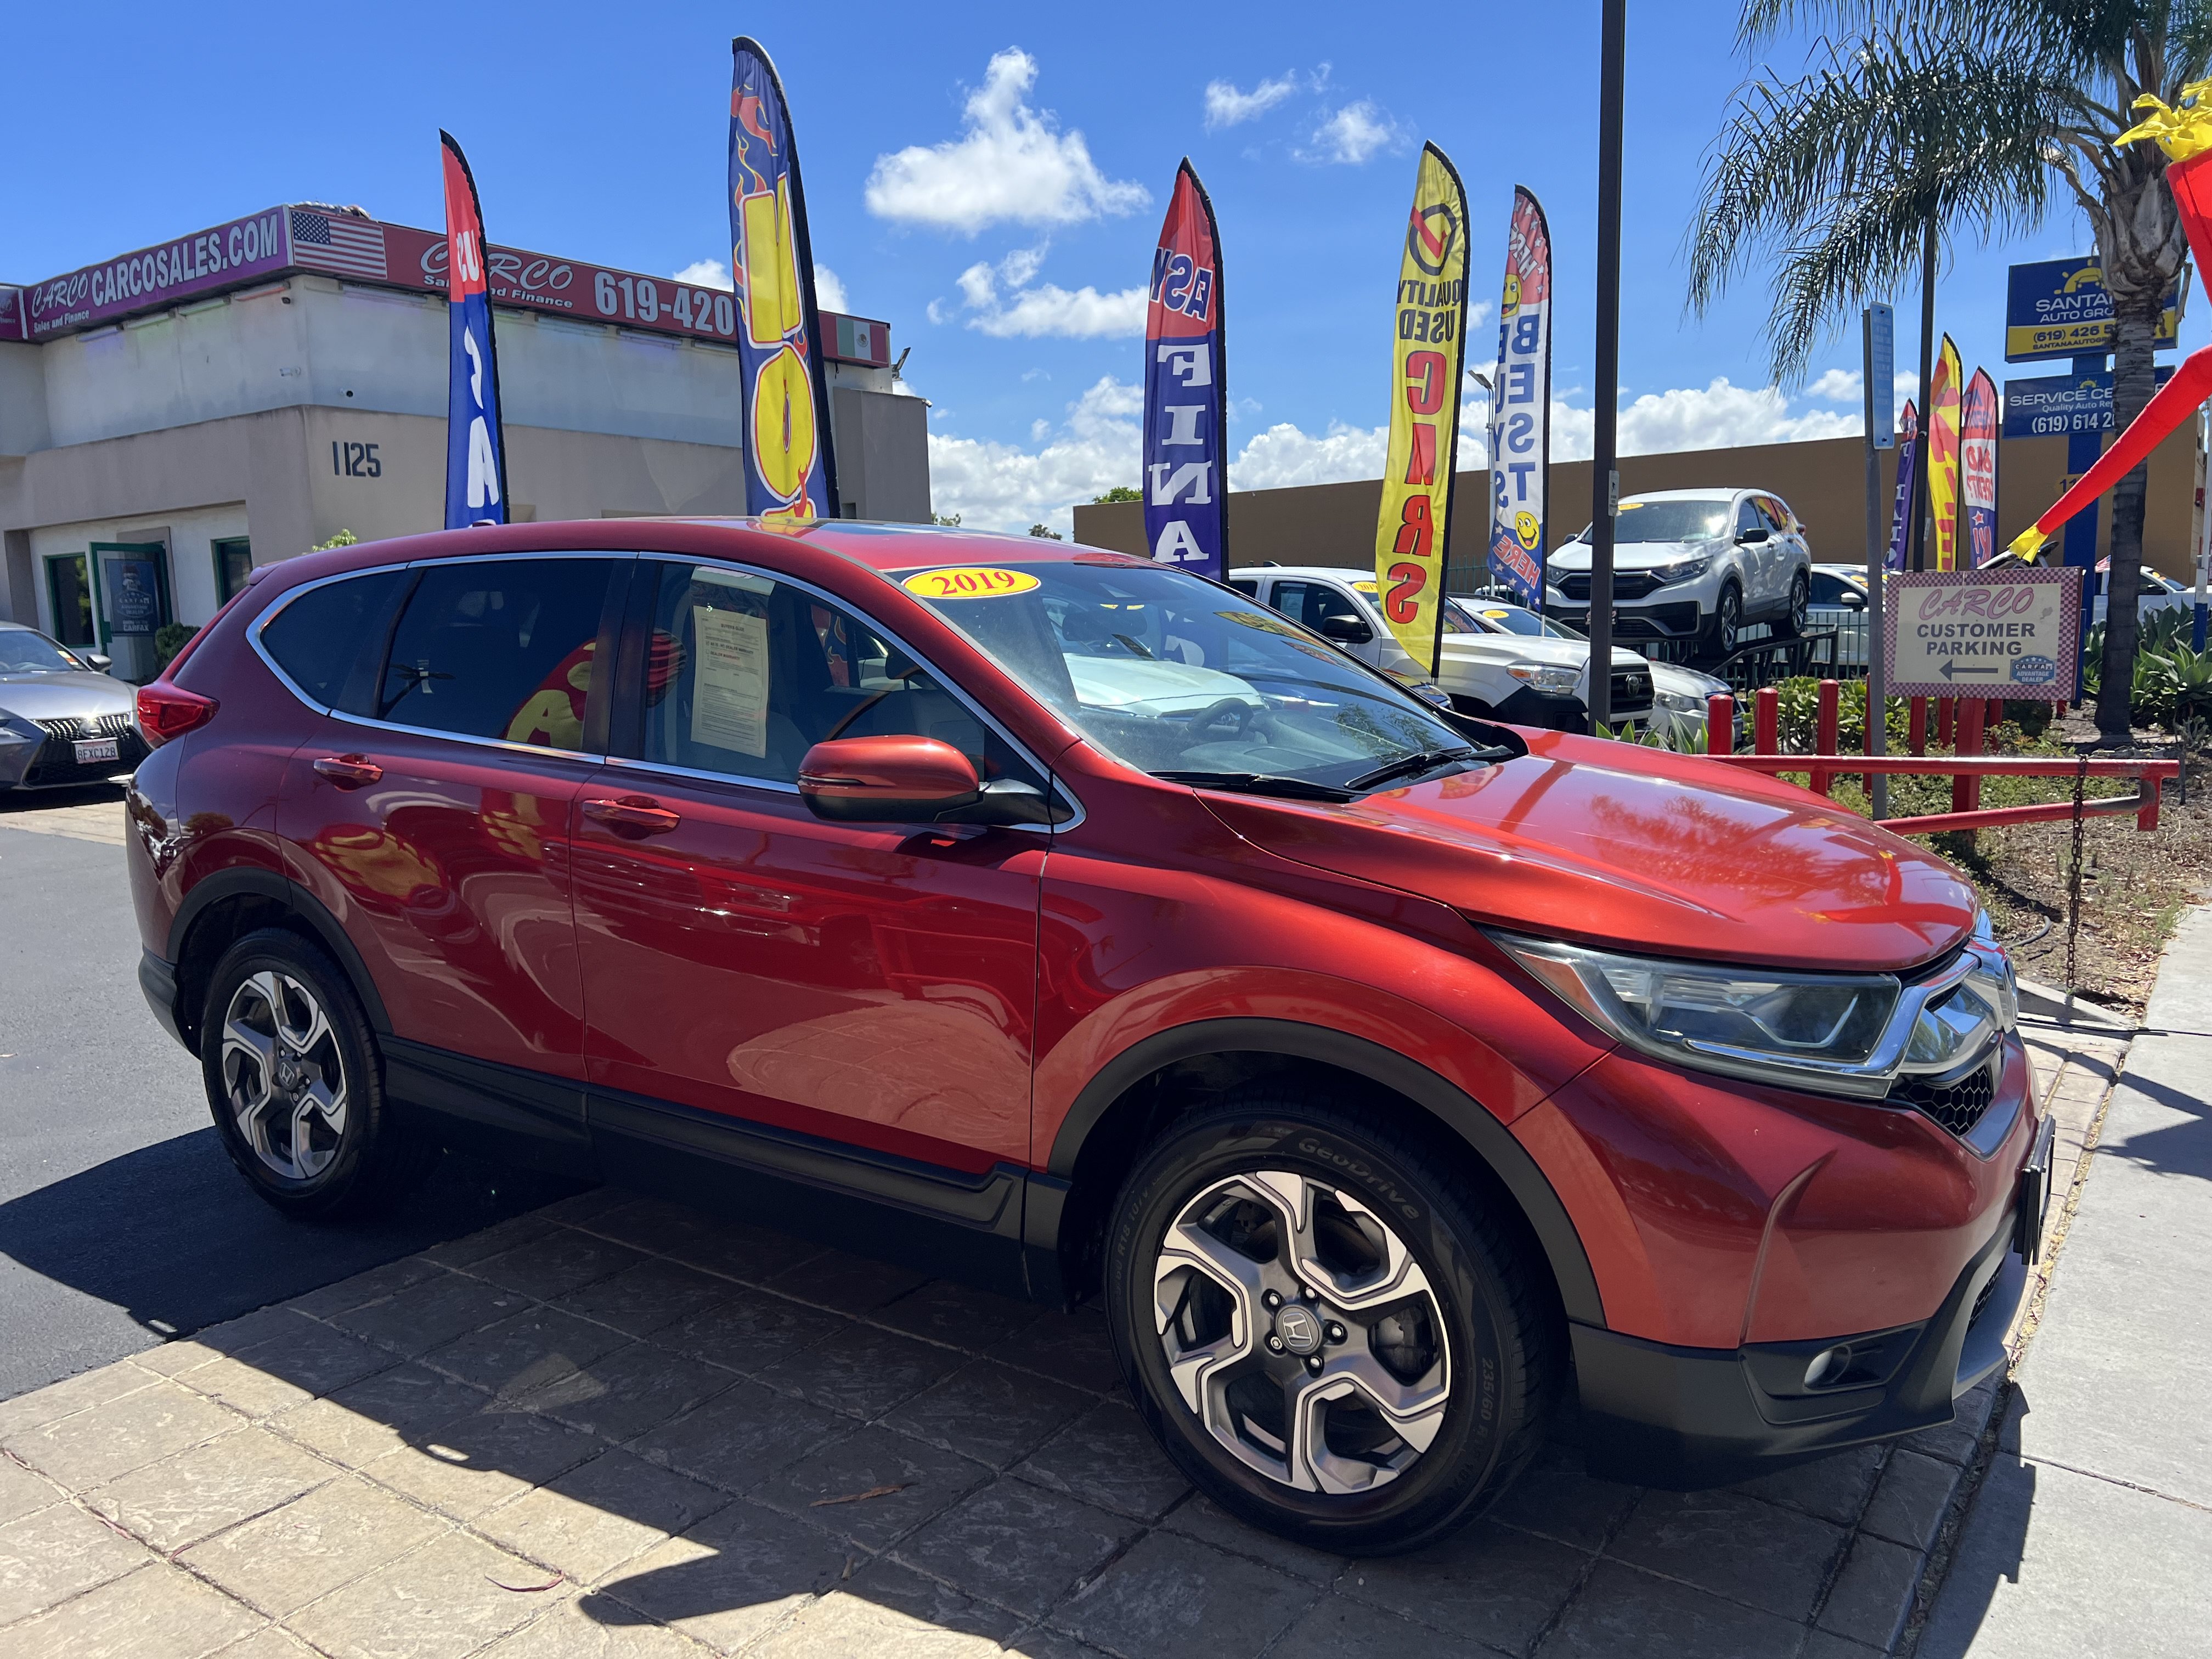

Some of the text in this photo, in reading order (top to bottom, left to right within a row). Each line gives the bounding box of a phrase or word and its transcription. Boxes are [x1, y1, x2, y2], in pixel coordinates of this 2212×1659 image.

[31, 214, 278, 318] CARCO CARCOSALES.COM
[420, 241, 573, 290] CRCO
[511, 289, 573, 308] Finance
[52, 316, 63, 328] and
[64, 309, 89, 325] Finance
[2040, 311, 2080, 323] AUTO
[2033, 329, 2066, 343] (619)
[2070, 325, 2100, 337] 426
[2010, 389, 2087, 407] SERVICE
[2042, 403, 2074, 413] Quality
[2075, 400, 2097, 409] Auto
[2032, 415, 2069, 433] (619)
[2073, 413, 2098, 430] 614
[332, 441, 381, 477] 1125
[932, 571, 1015, 595] 2019
[1918, 586, 2034, 620] CARCO
[1917, 623, 2036, 637] CUSTOMER
[1926, 641, 2022, 656] PARKING
